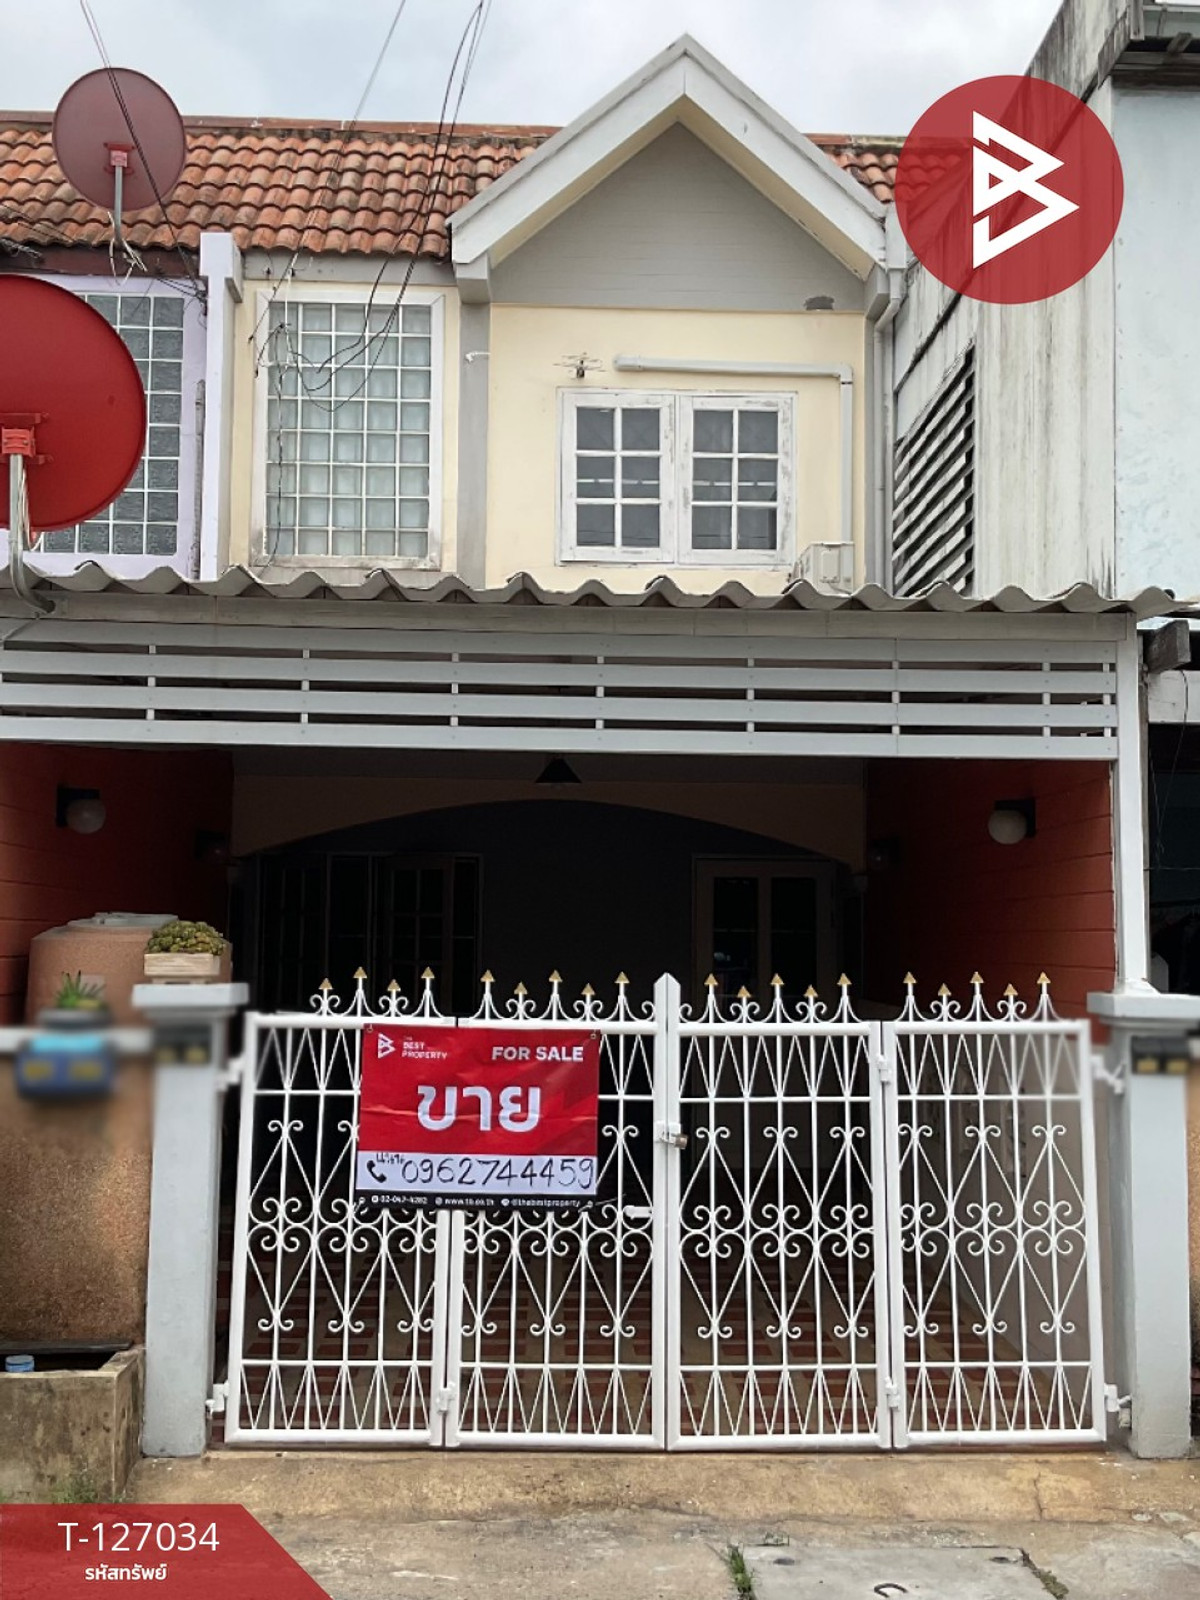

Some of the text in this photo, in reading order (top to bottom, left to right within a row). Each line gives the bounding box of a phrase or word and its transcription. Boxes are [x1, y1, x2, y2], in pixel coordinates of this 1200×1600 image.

[403, 1041, 425, 1050] BEST
[401, 1050, 448, 1060] PROPERTY
[491, 1046, 584, 1062] FOR SALE
[417, 1085, 541, 1132] ขาย
[401, 1158, 594, 1189] 0962744459
